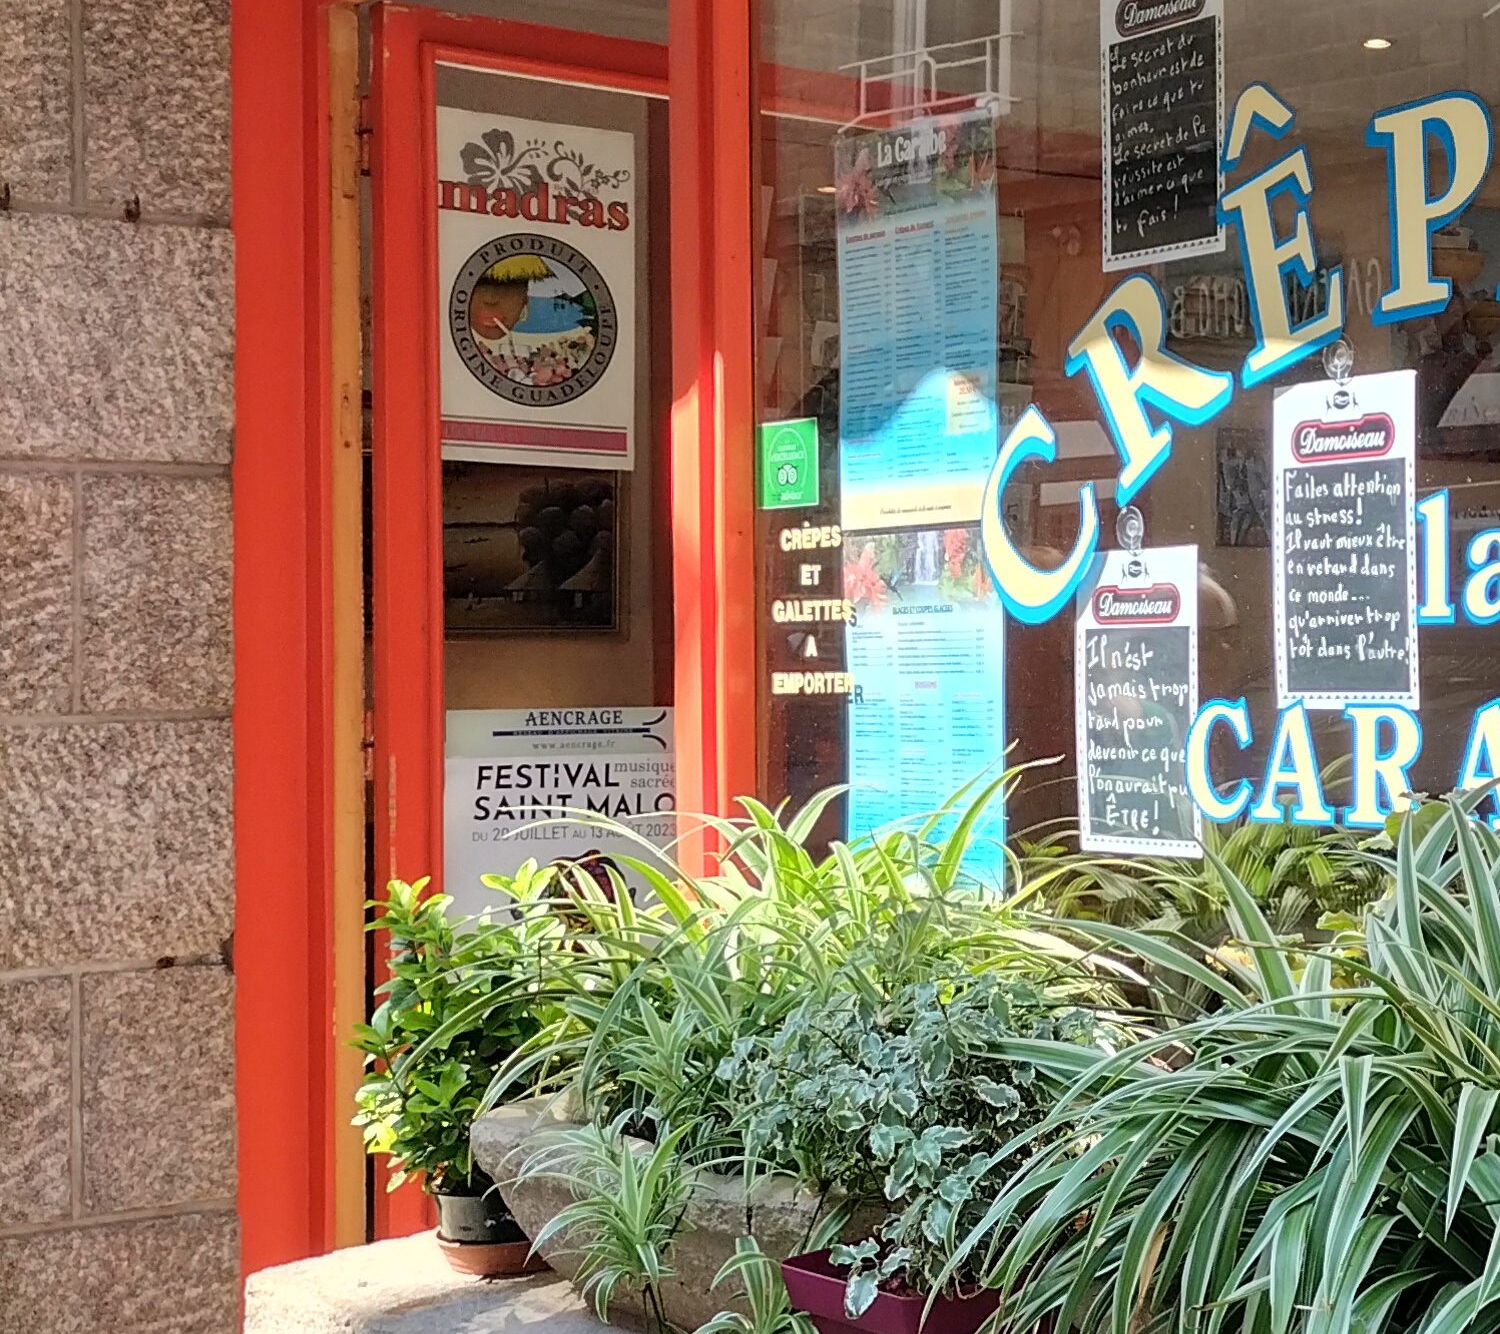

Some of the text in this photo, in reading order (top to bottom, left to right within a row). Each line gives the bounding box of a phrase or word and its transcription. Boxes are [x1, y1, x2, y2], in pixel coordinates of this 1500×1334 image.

[1131, 37, 1173, 67] secret
[1178, 33, 1194, 49] du
[1112, 50, 1204, 96] bonheur est de
[1163, 86, 1184, 112] que
[1190, 79, 1204, 96] tu
[1134, 132, 1173, 159] secret
[1176, 126, 1188, 143] de
[1192, 114, 1206, 137] la
[878, 141, 892, 167] La
[1167, 154, 1184, 172] est
[1181, 169, 1203, 194] que
[439, 180, 629, 231] madras
[1116, 218, 1128, 234] tu
[480, 237, 593, 275] PRODUIT
[454, 290, 613, 404] ORIGINE GUADELOUPE
[1300, 426, 1386, 455] Damoiseau
[1285, 470, 1401, 502] Faites attention
[1285, 512, 1303, 526] au
[779, 520, 842, 552] CRÊPES
[1285, 523, 1406, 554] Il vaut mieux être
[800, 564, 822, 586] ET
[1287, 553, 1396, 577] en retard dans
[1099, 592, 1172, 617] Damoiseau
[1289, 588, 1302, 603] ce
[772, 598, 853, 623] GALETTES
[1289, 605, 1400, 638] qu'arriver trop
[804, 633, 819, 657] A
[1086, 634, 1154, 670] Il n'est
[1290, 633, 1313, 658] tôt
[1318, 636, 1351, 660] dans
[771, 671, 853, 695] EMPORTER
[1088, 673, 1188, 707] jamais trop
[525, 710, 623, 726] AENCRAGE
[1088, 706, 1163, 747] tard pour
[532, 739, 615, 750] www.aencrage.fr
[1088, 738, 1185, 772] devenir ce que
[476, 763, 620, 790] FESTIVAL
[1088, 763, 1188, 808] l'on aurait pu
[473, 793, 676, 821] SAINT MALO
[472, 832, 488, 842] DU
[514, 826, 570, 841] JUILLET
[572, 829, 586, 839] AU
[591, 826, 603, 839] 13
